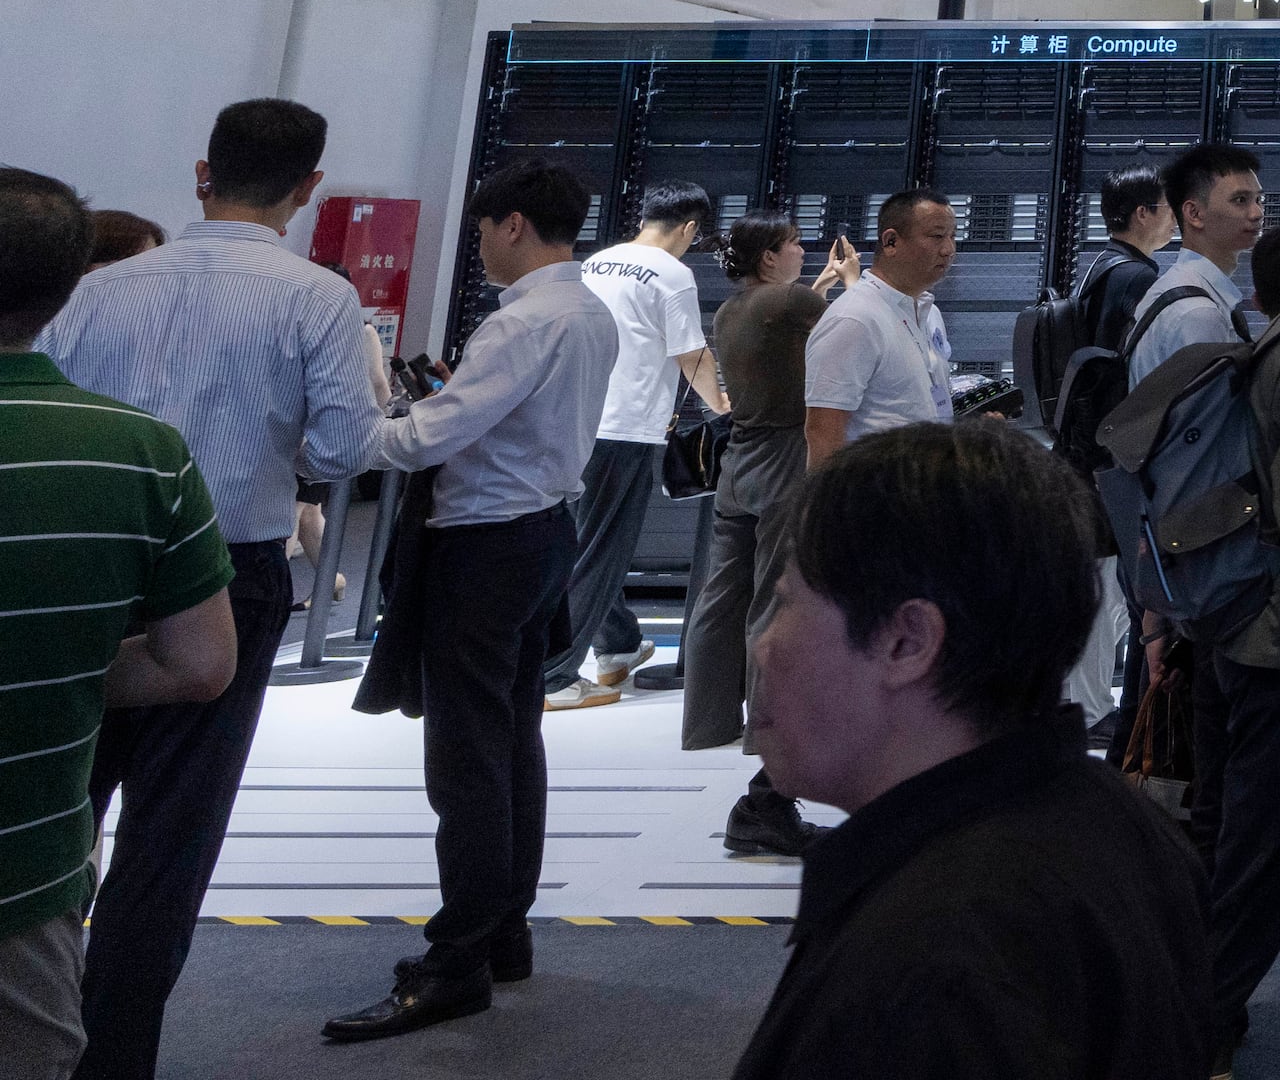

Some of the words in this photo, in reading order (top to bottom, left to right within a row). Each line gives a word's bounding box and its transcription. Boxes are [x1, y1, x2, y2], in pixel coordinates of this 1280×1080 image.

[991, 35, 1068, 54] 计算柜
[1088, 35, 1177, 56] Compute
[360, 253, 395, 269] 消火栓
